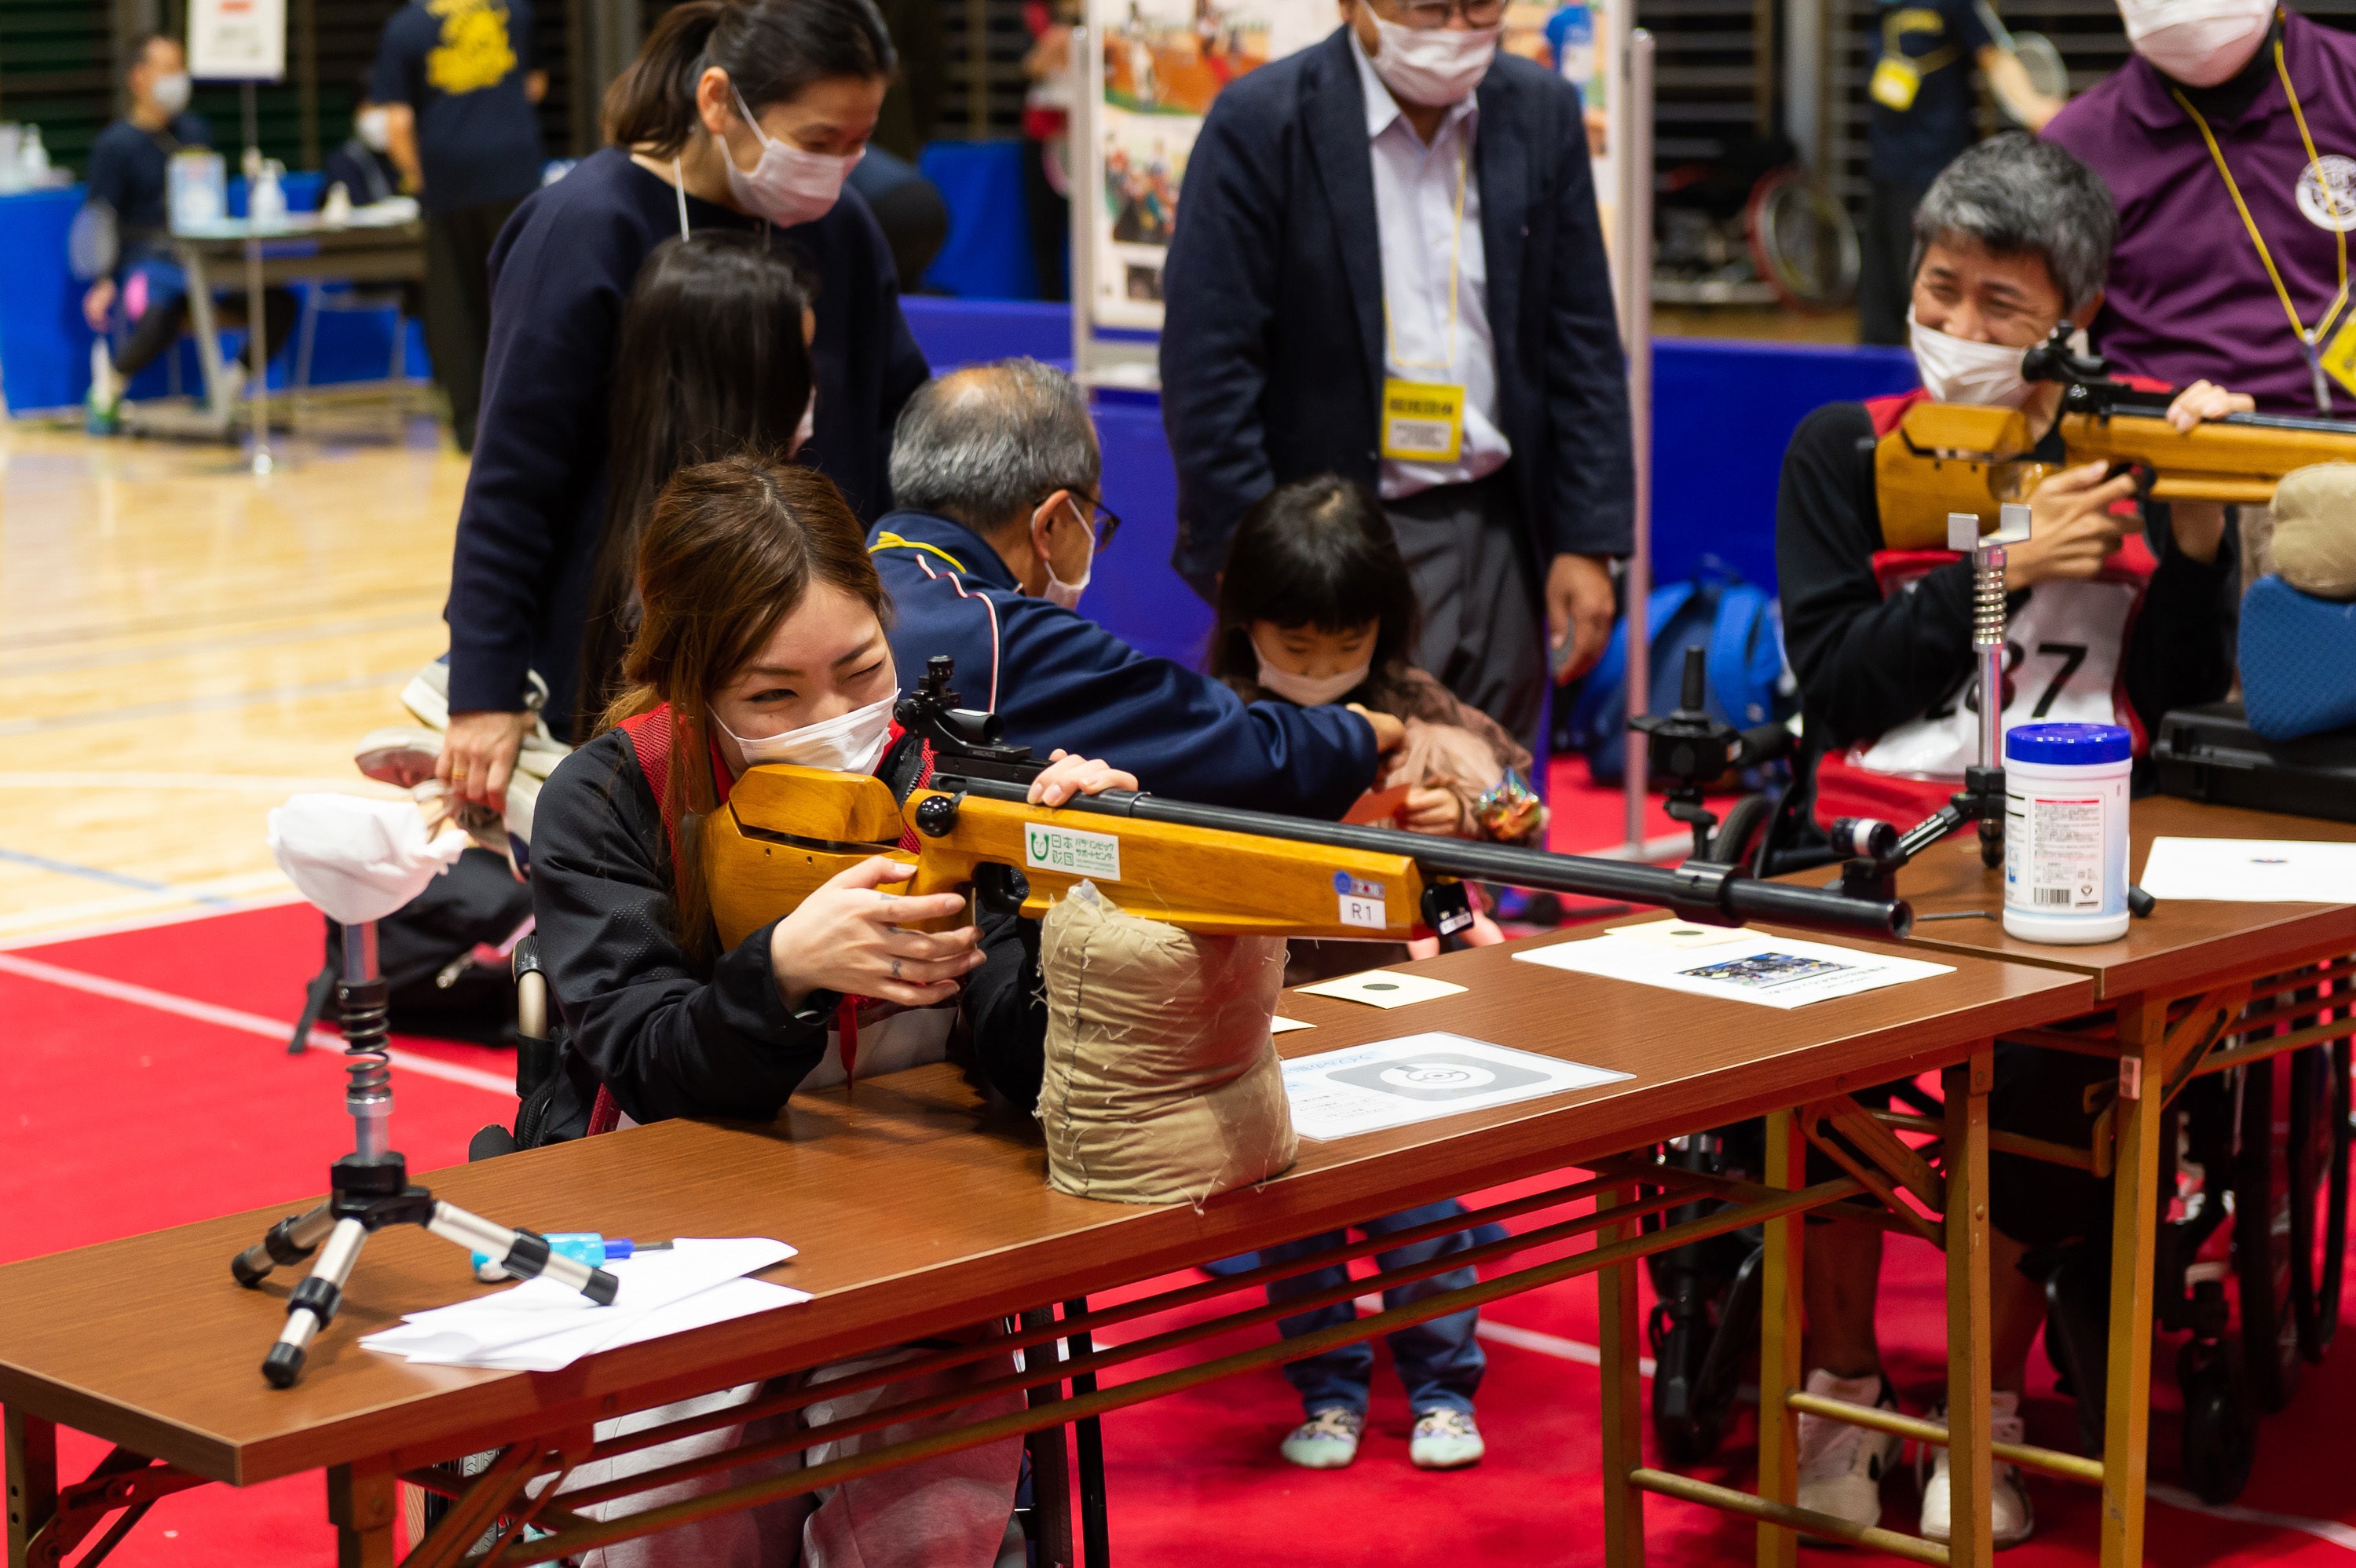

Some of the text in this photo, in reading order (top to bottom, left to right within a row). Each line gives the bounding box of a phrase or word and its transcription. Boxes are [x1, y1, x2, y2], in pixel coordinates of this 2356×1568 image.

[1925, 640, 2087, 720] 87
[1051, 834, 1073, 850] 日本
[1352, 903, 1372, 921] R1
